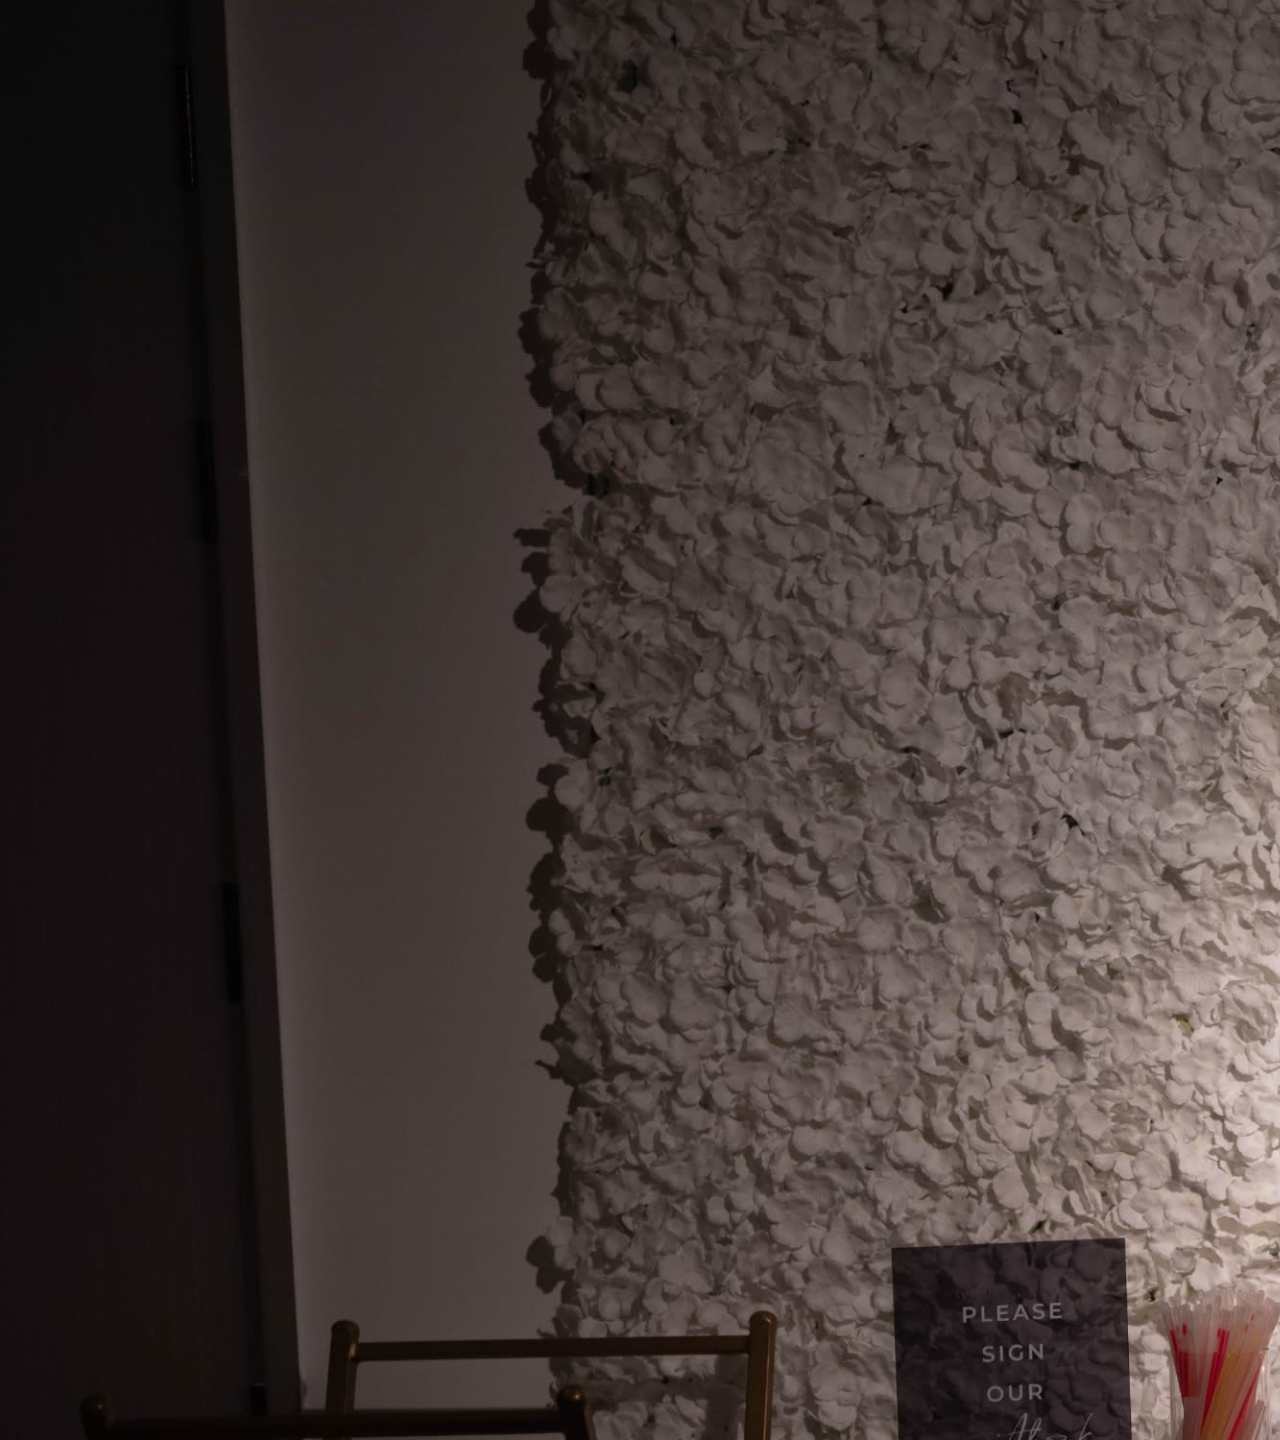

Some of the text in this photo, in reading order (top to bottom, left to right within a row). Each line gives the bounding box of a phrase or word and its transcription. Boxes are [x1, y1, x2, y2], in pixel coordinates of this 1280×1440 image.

[962, 1301, 1064, 1324] PLEASE
[981, 1343, 1046, 1364] SIGN
[986, 1383, 1044, 1403] OUR
